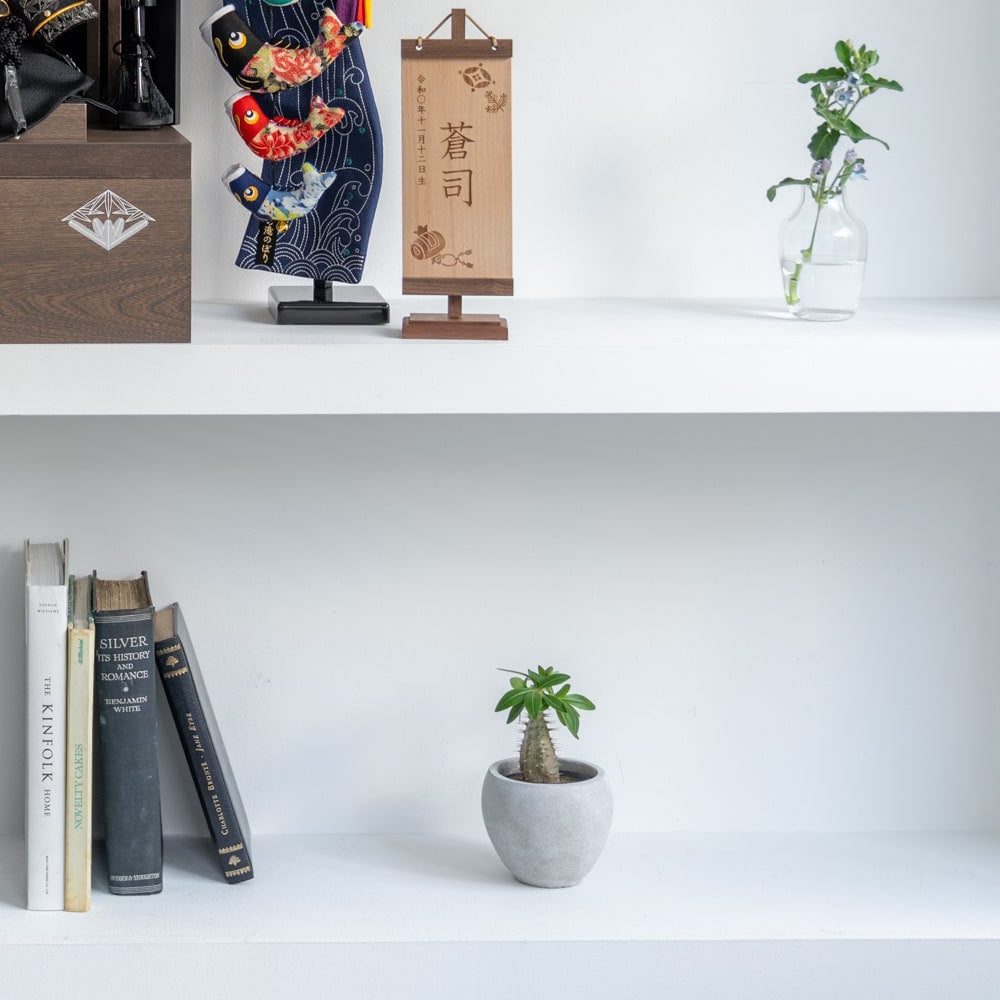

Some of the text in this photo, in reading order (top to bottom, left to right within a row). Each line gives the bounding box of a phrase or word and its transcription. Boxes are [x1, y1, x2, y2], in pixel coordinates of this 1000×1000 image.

[440, 121, 475, 207] 蒼司
[99, 635, 149, 649] SILVER
[113, 650, 151, 662] HISTORY
[101, 670, 149, 681] ROMANCE
[104, 696, 148, 705] BENJAMIN
[113, 705, 142, 713] WHITE
[41, 704, 54, 782] KINFOLK
[74, 743, 83, 829] NOVELTY CAKES
[43, 789, 51, 817] HOME
